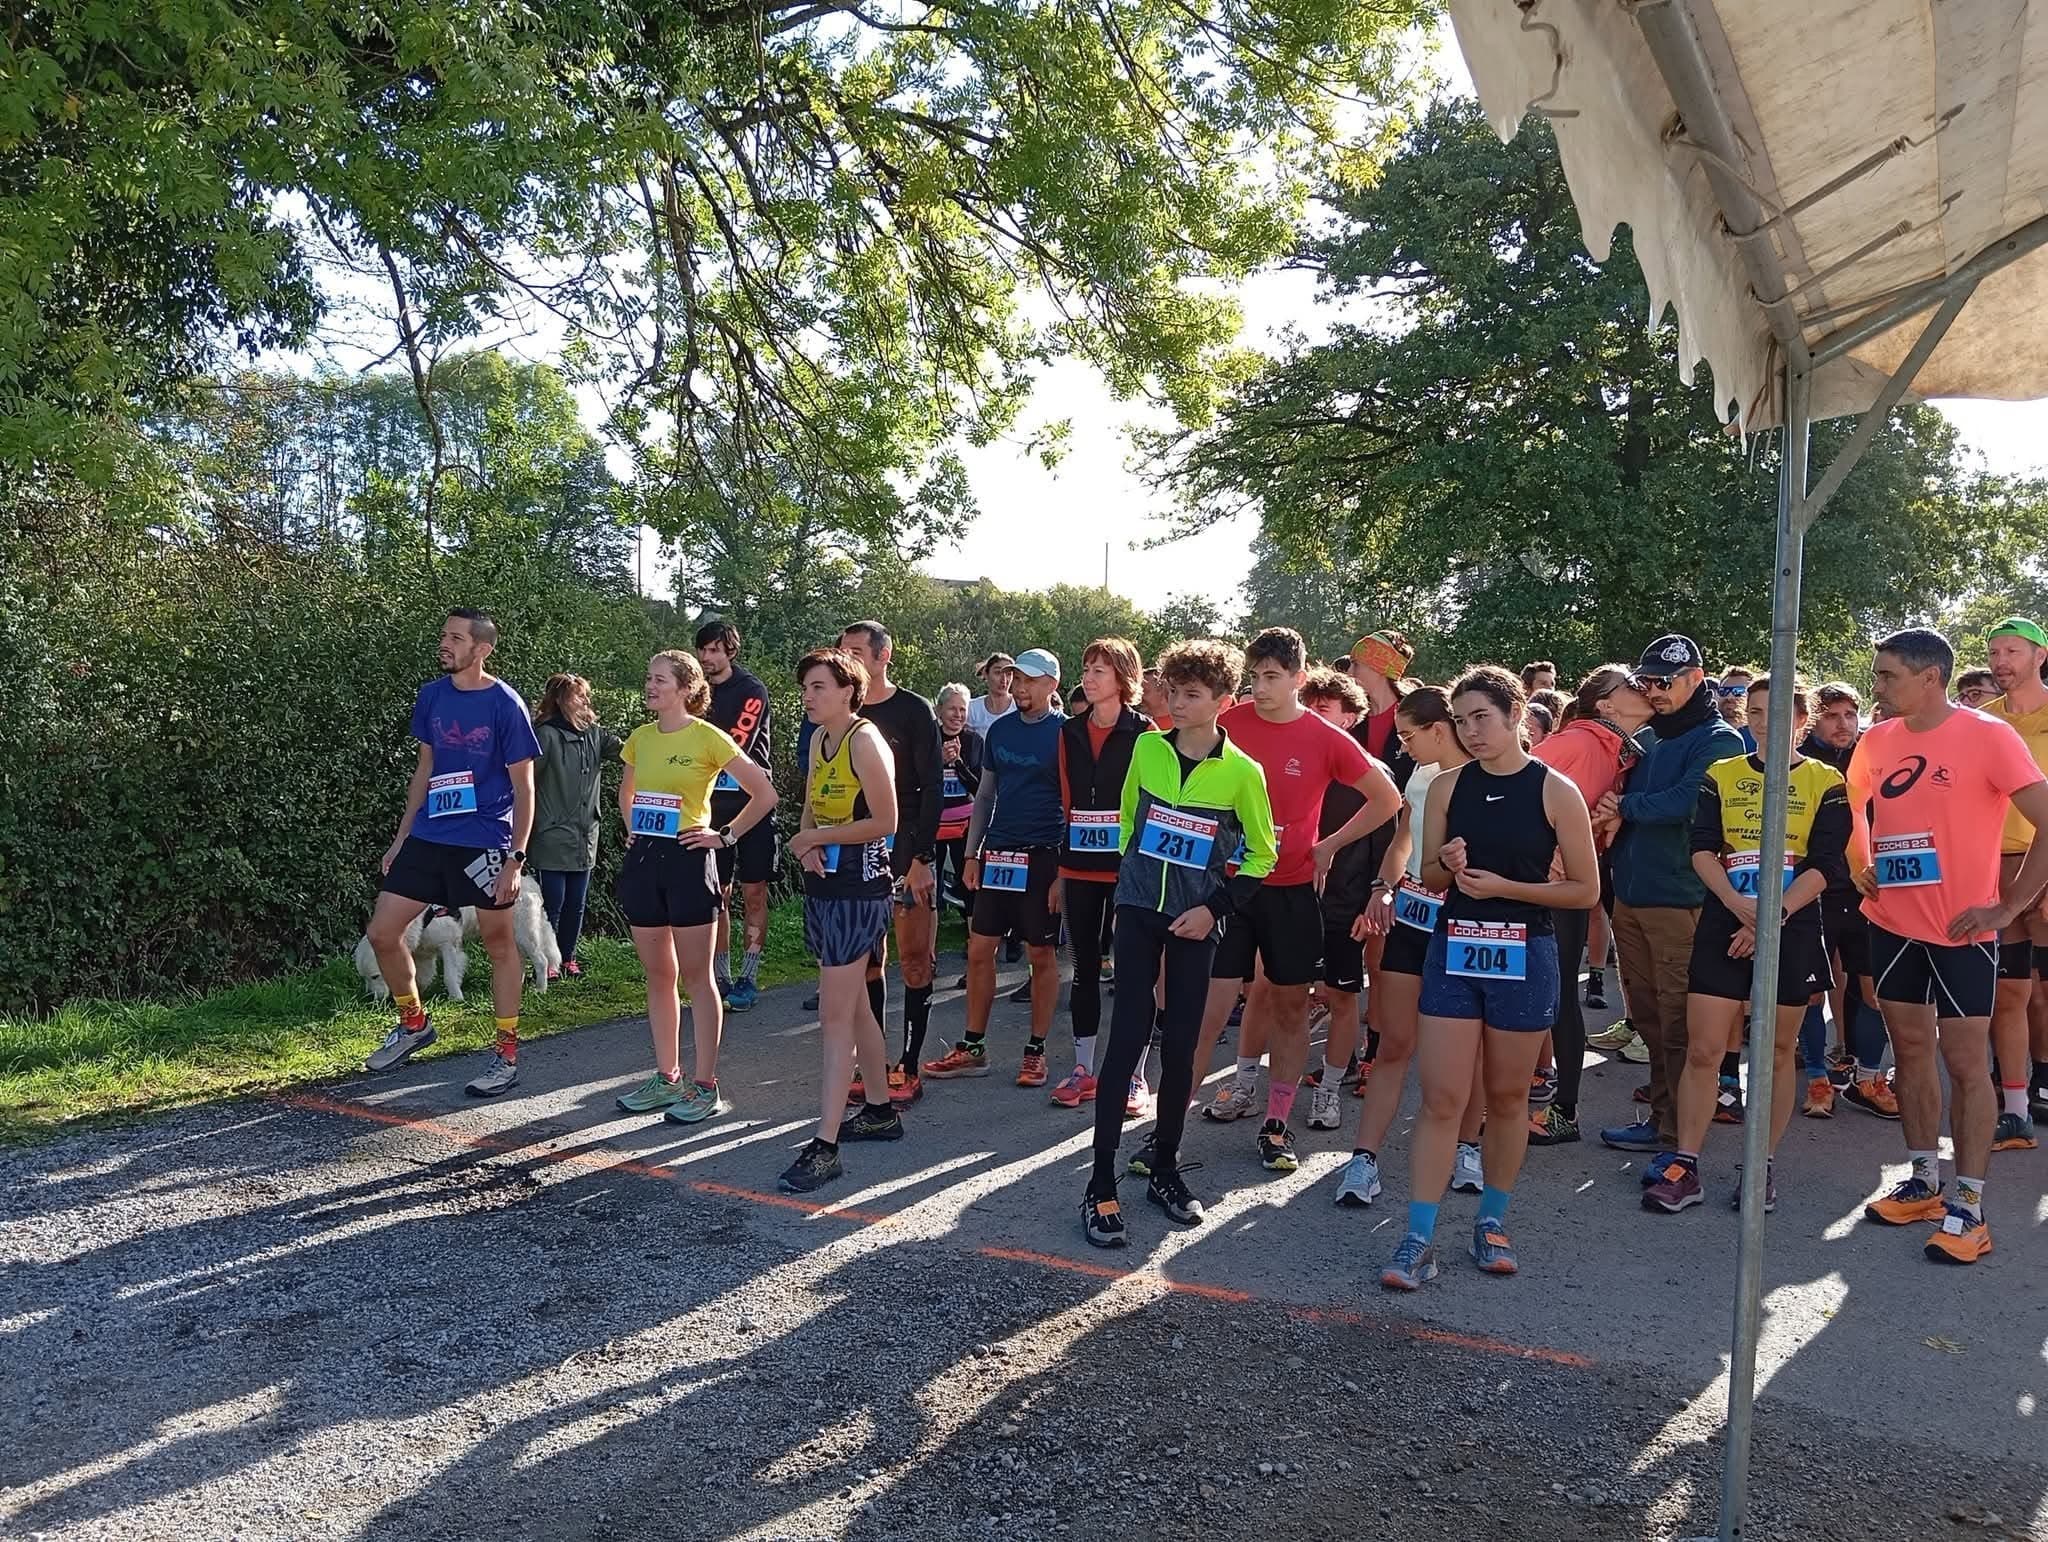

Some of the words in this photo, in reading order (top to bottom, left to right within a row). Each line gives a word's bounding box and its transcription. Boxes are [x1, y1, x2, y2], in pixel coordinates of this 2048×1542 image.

[456, 776, 469, 784] 23
[436, 791, 463, 812] 202
[663, 799, 677, 807] 23
[637, 811, 666, 832] 268
[1153, 811, 1193, 829] COCHS
[1194, 824, 1211, 834] 23
[1080, 829, 1108, 847] 249
[1156, 831, 1195, 860] 231
[1877, 841, 1910, 851] COCHS
[1911, 839, 1929, 848] 23
[1730, 855, 1761, 866] COCH
[1886, 857, 1923, 881] 263
[992, 868, 1015, 886] 217
[1404, 899, 1430, 924] 240
[1454, 927, 1499, 938] COCHS
[1501, 930, 1520, 939] 23
[1463, 945, 1508, 972] 204
